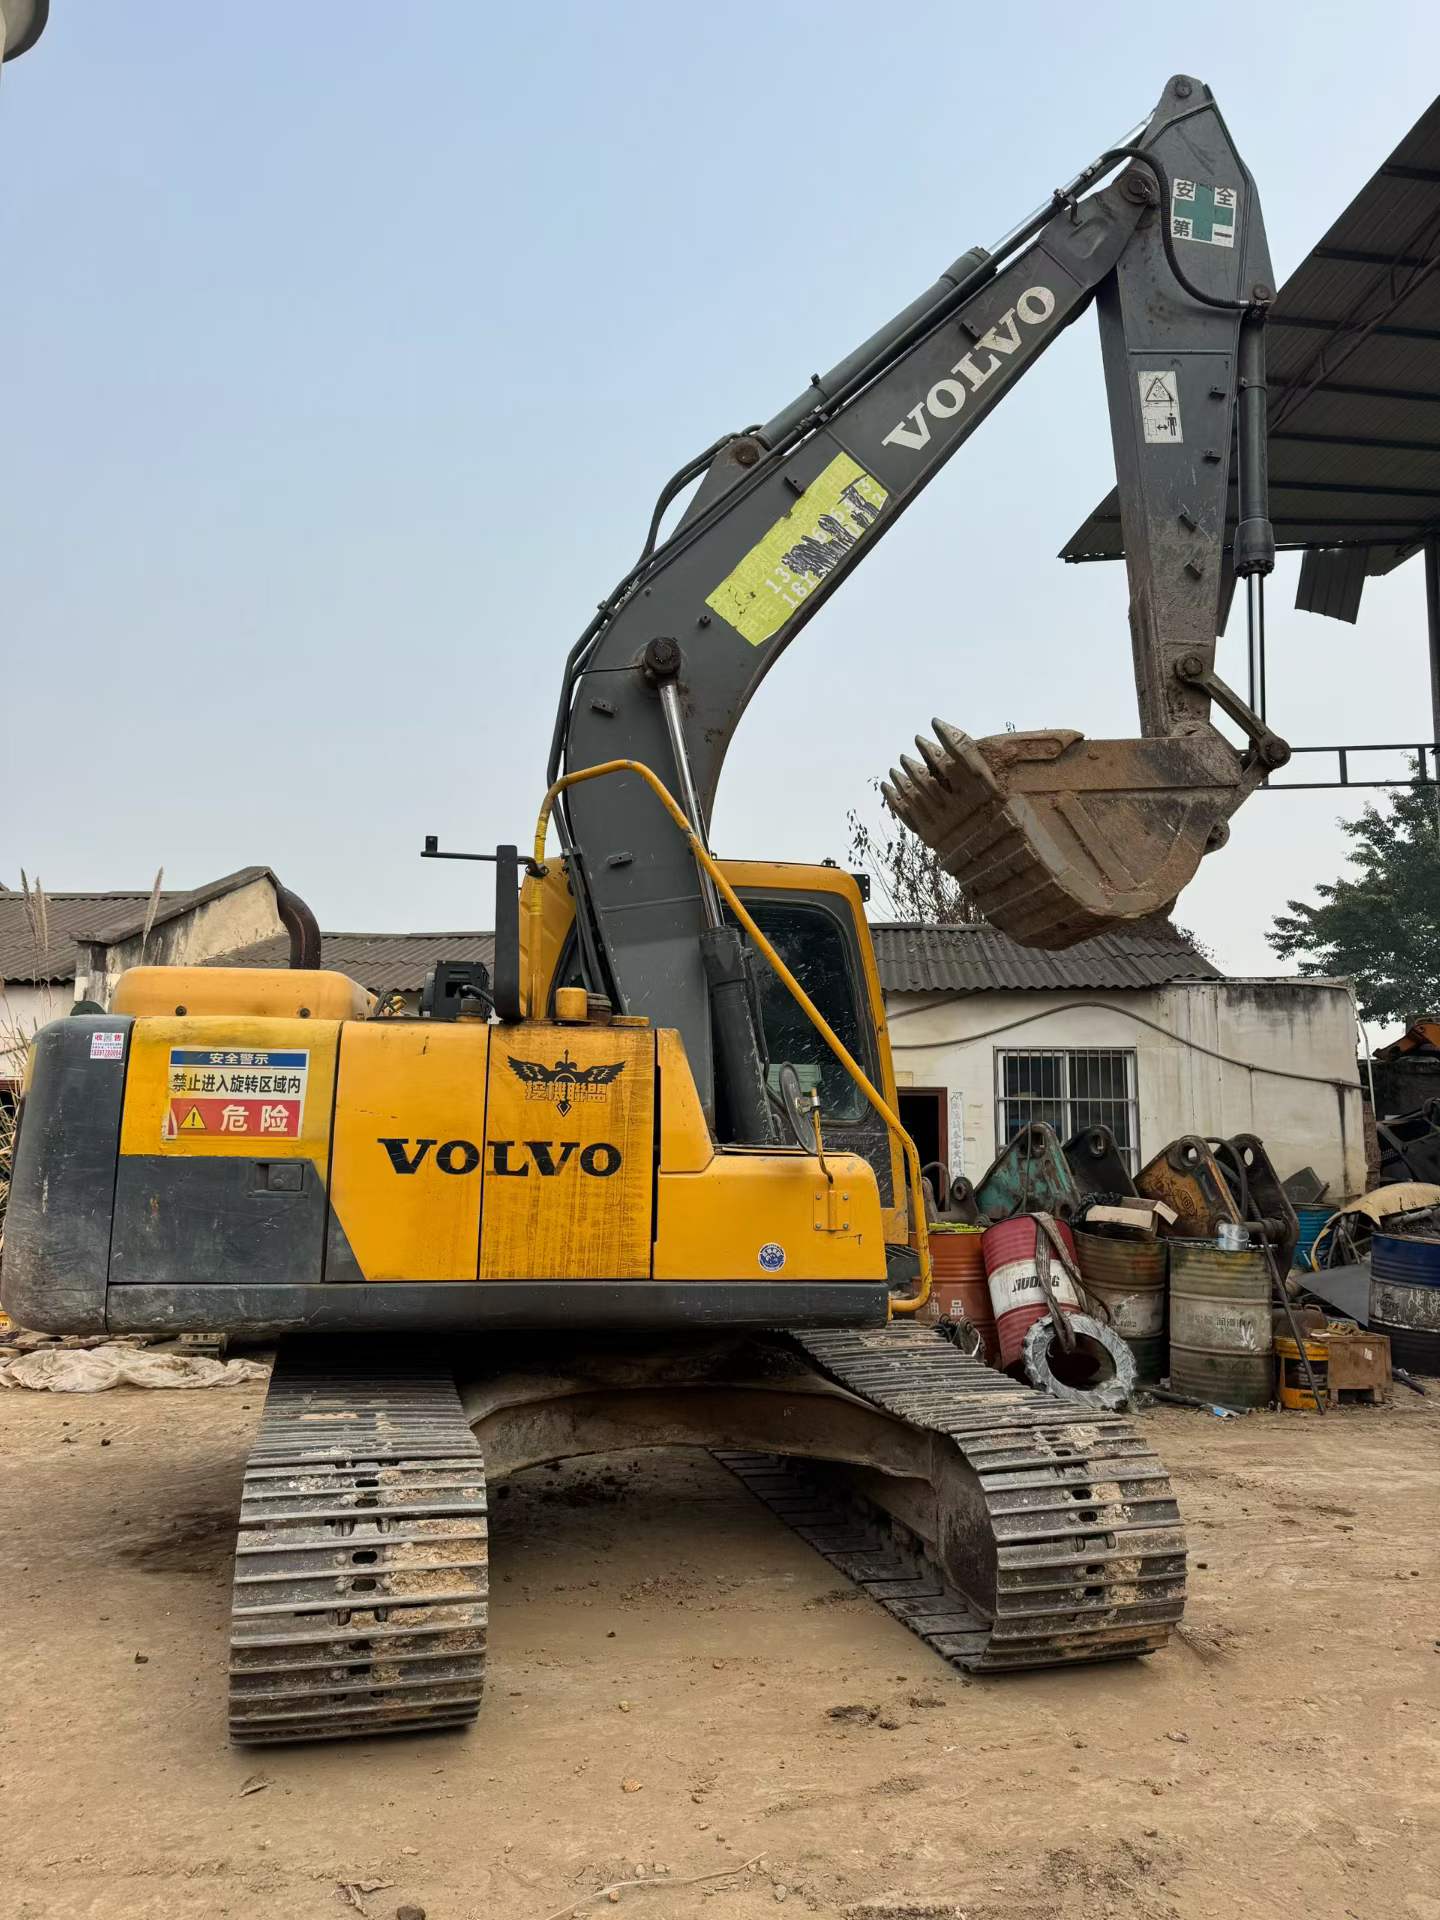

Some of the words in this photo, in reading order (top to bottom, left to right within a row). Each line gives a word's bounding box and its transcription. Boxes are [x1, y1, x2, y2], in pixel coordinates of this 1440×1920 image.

[1175, 180, 1233, 206] 安全
[1173, 219, 1232, 239] 第一
[881, 286, 1055, 450] VOLVO
[209, 1053, 268, 1065] 安全警示
[172, 1073, 301, 1094] 禁止进入旋转区域内
[220, 1104, 289, 1132] 危险
[377, 1138, 622, 1177] VOLVO
[1012, 1275, 1060, 1292] JIUDG
